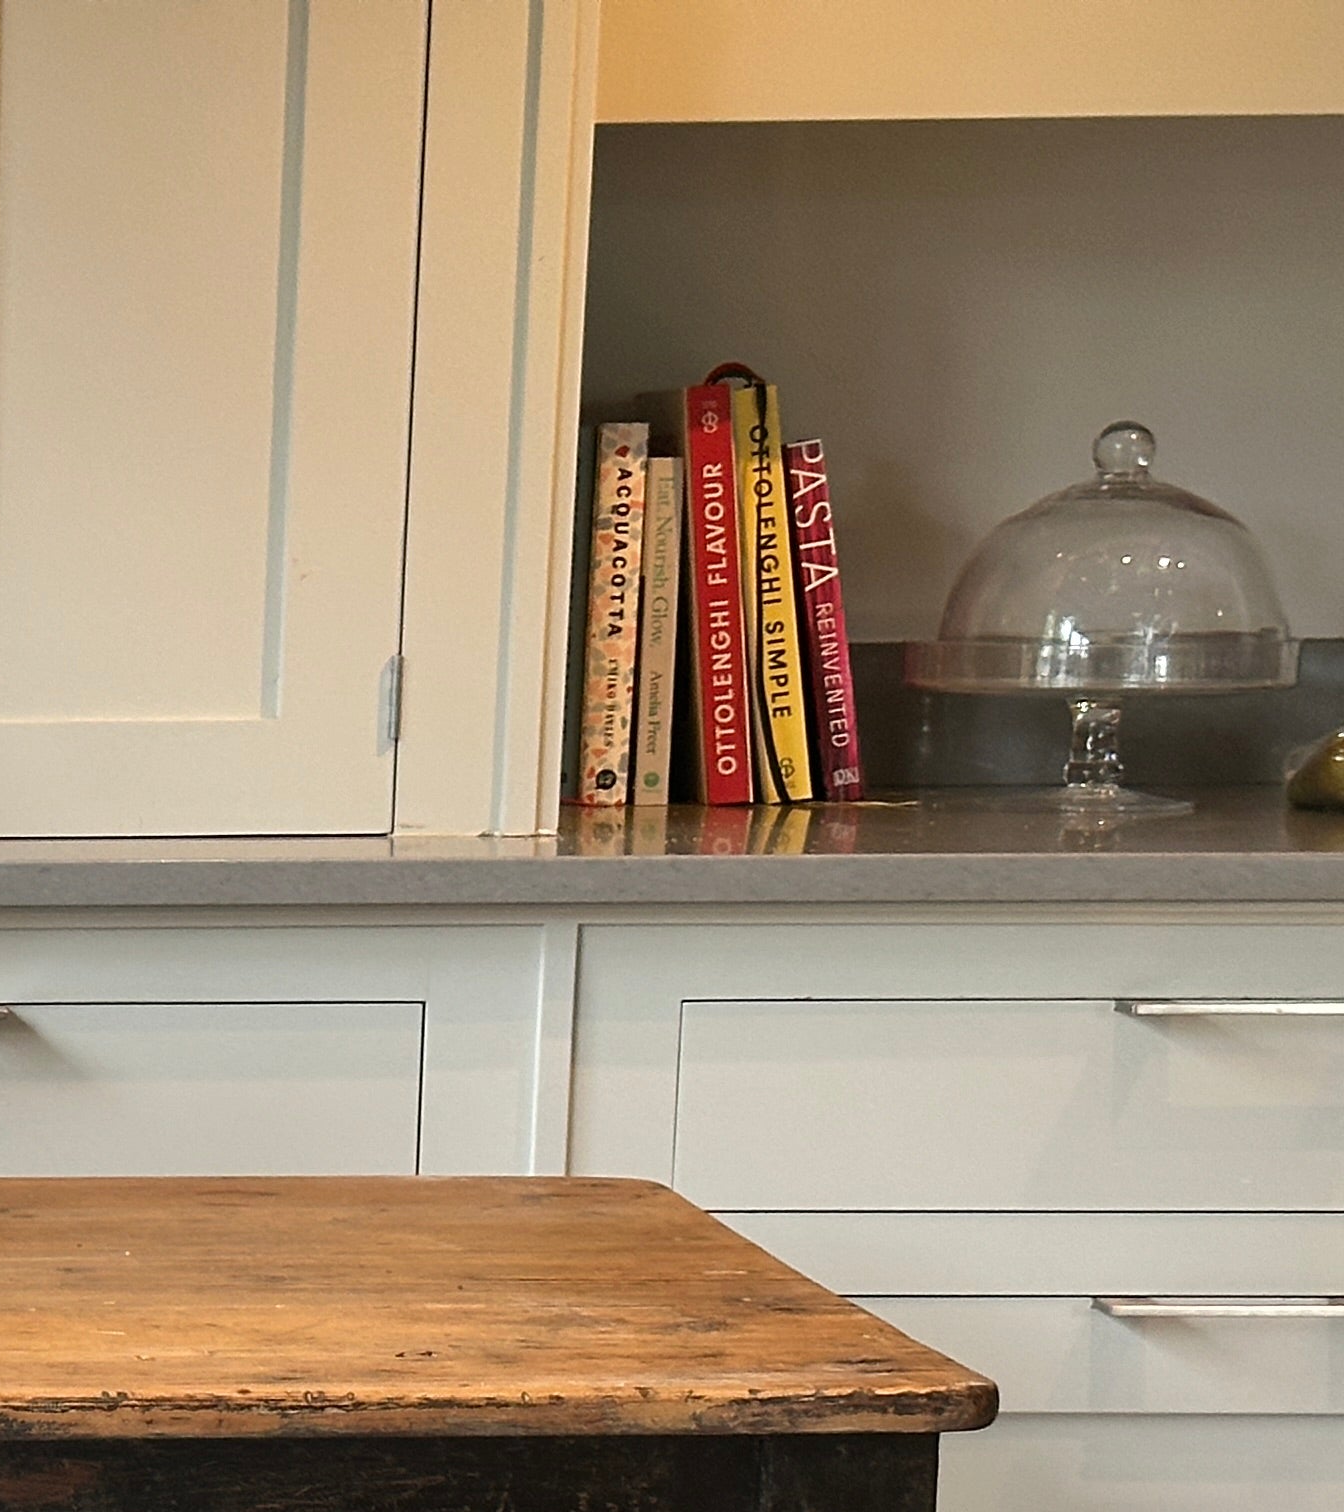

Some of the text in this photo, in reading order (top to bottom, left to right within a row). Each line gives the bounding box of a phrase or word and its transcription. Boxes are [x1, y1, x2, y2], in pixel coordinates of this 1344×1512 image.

[607, 467, 633, 637] ACQUACOTTA
[702, 462, 737, 775] OTTOLENGHI FLAVOUR
[749, 424, 792, 719] OTTOLENGHI SIMPLE
[786, 438, 850, 748] PASTA REINVENTED
